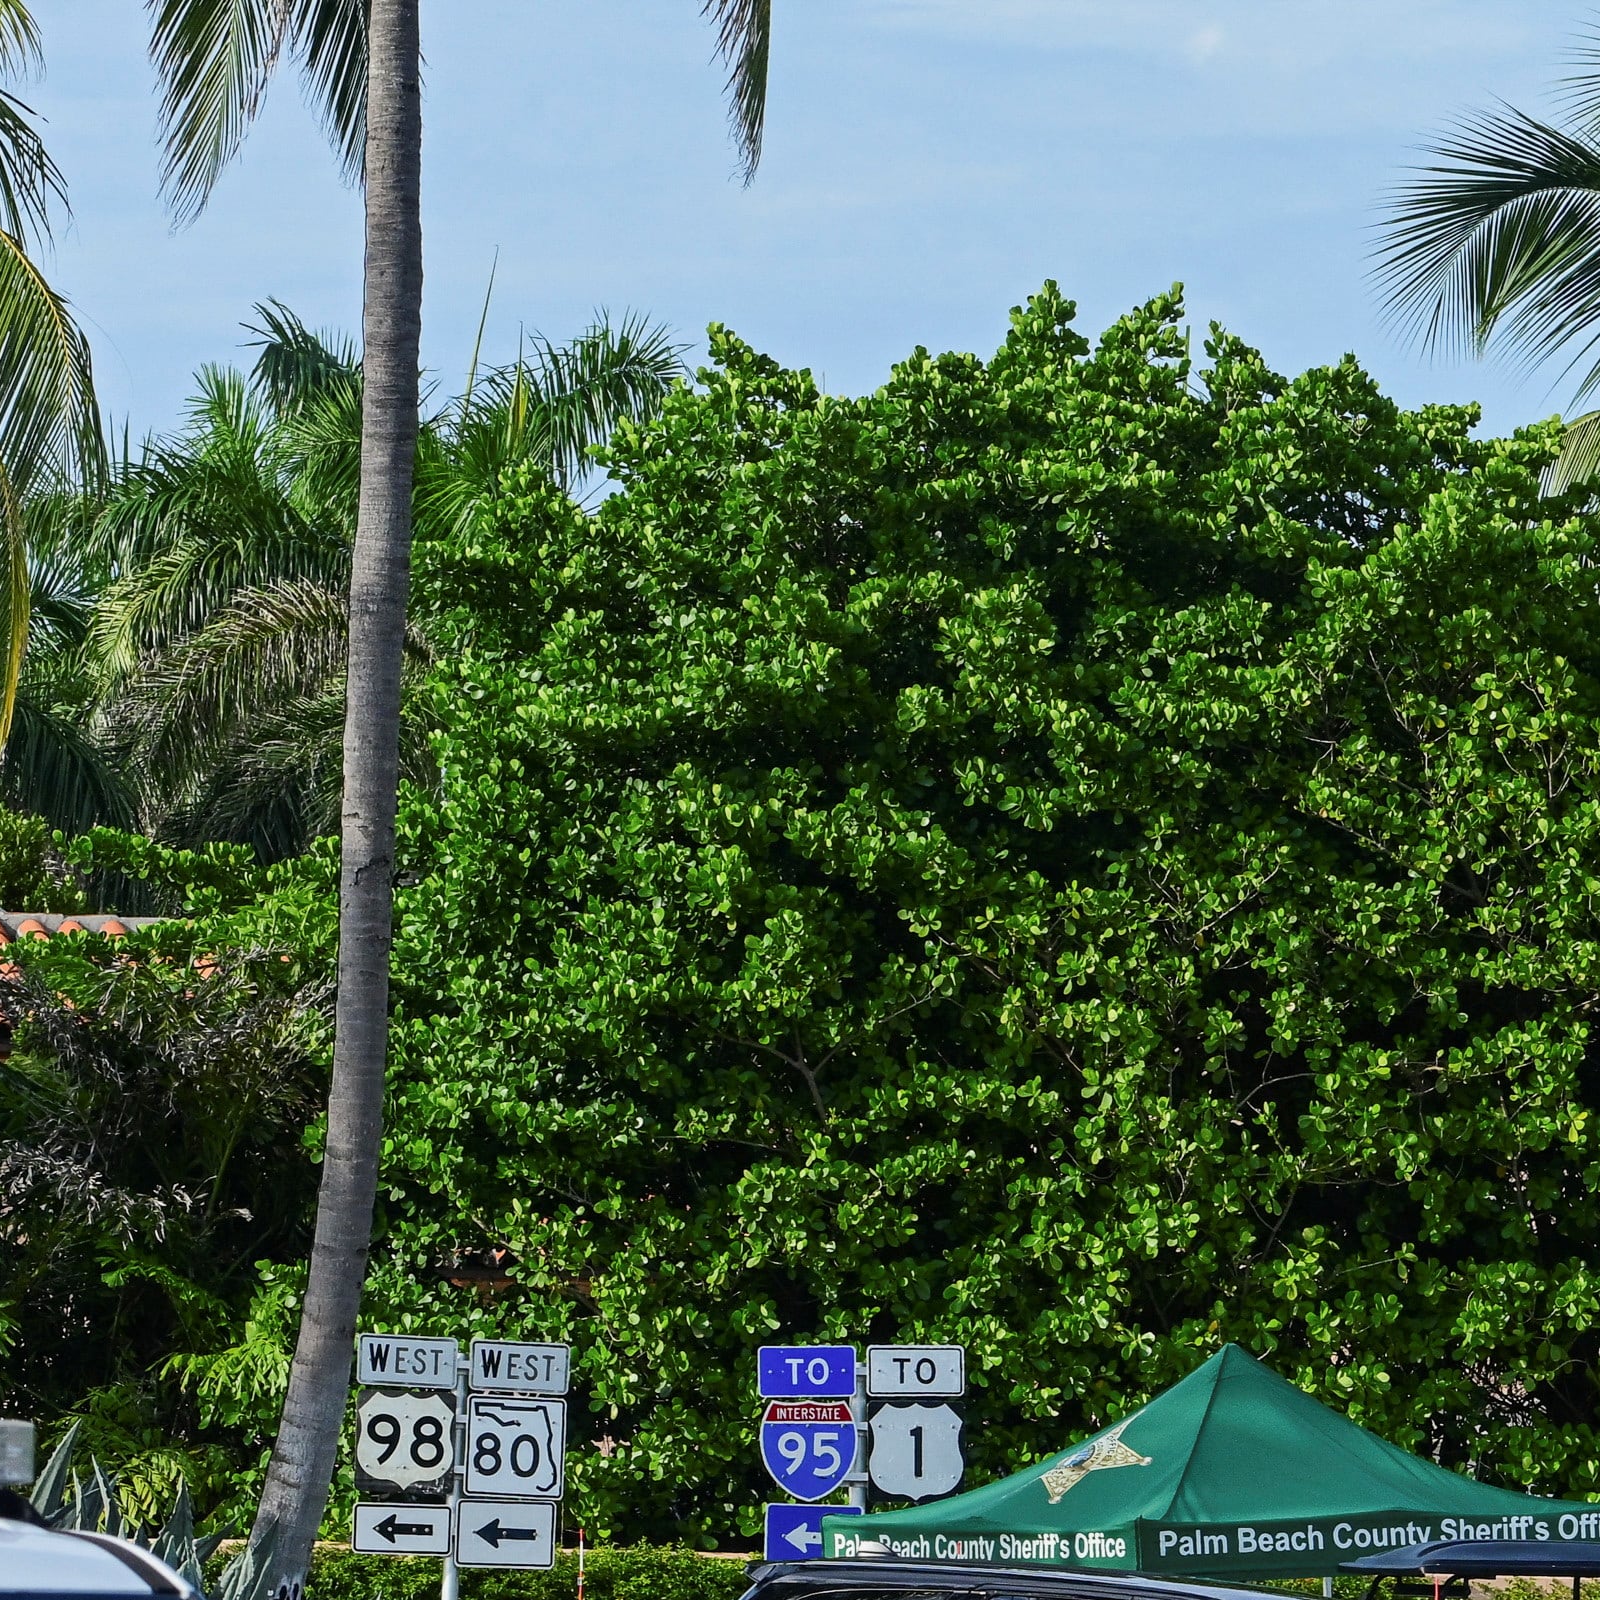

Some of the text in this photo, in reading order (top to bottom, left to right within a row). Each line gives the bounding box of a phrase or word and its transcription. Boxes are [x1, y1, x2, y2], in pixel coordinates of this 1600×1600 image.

[368, 1342, 444, 1375] WEST
[480, 1349, 556, 1382] WEST
[784, 1357, 830, 1386] TO
[892, 1357, 937, 1385] TO
[776, 1407, 841, 1421] INTERSTATE
[366, 1413, 445, 1469] 98
[473, 1432, 540, 1478] 80
[777, 1431, 842, 1477] 95
[909, 1425, 923, 1478] 1
[934, 1533, 996, 1561] County
[999, 1533, 1070, 1560] Sheriff's
[1074, 1532, 1126, 1559] Office
[1159, 1529, 1229, 1557] Palm
[1237, 1525, 1325, 1554] Beach
[1332, 1521, 1432, 1549] County
[1439, 1515, 1550, 1541] Sheriff's
